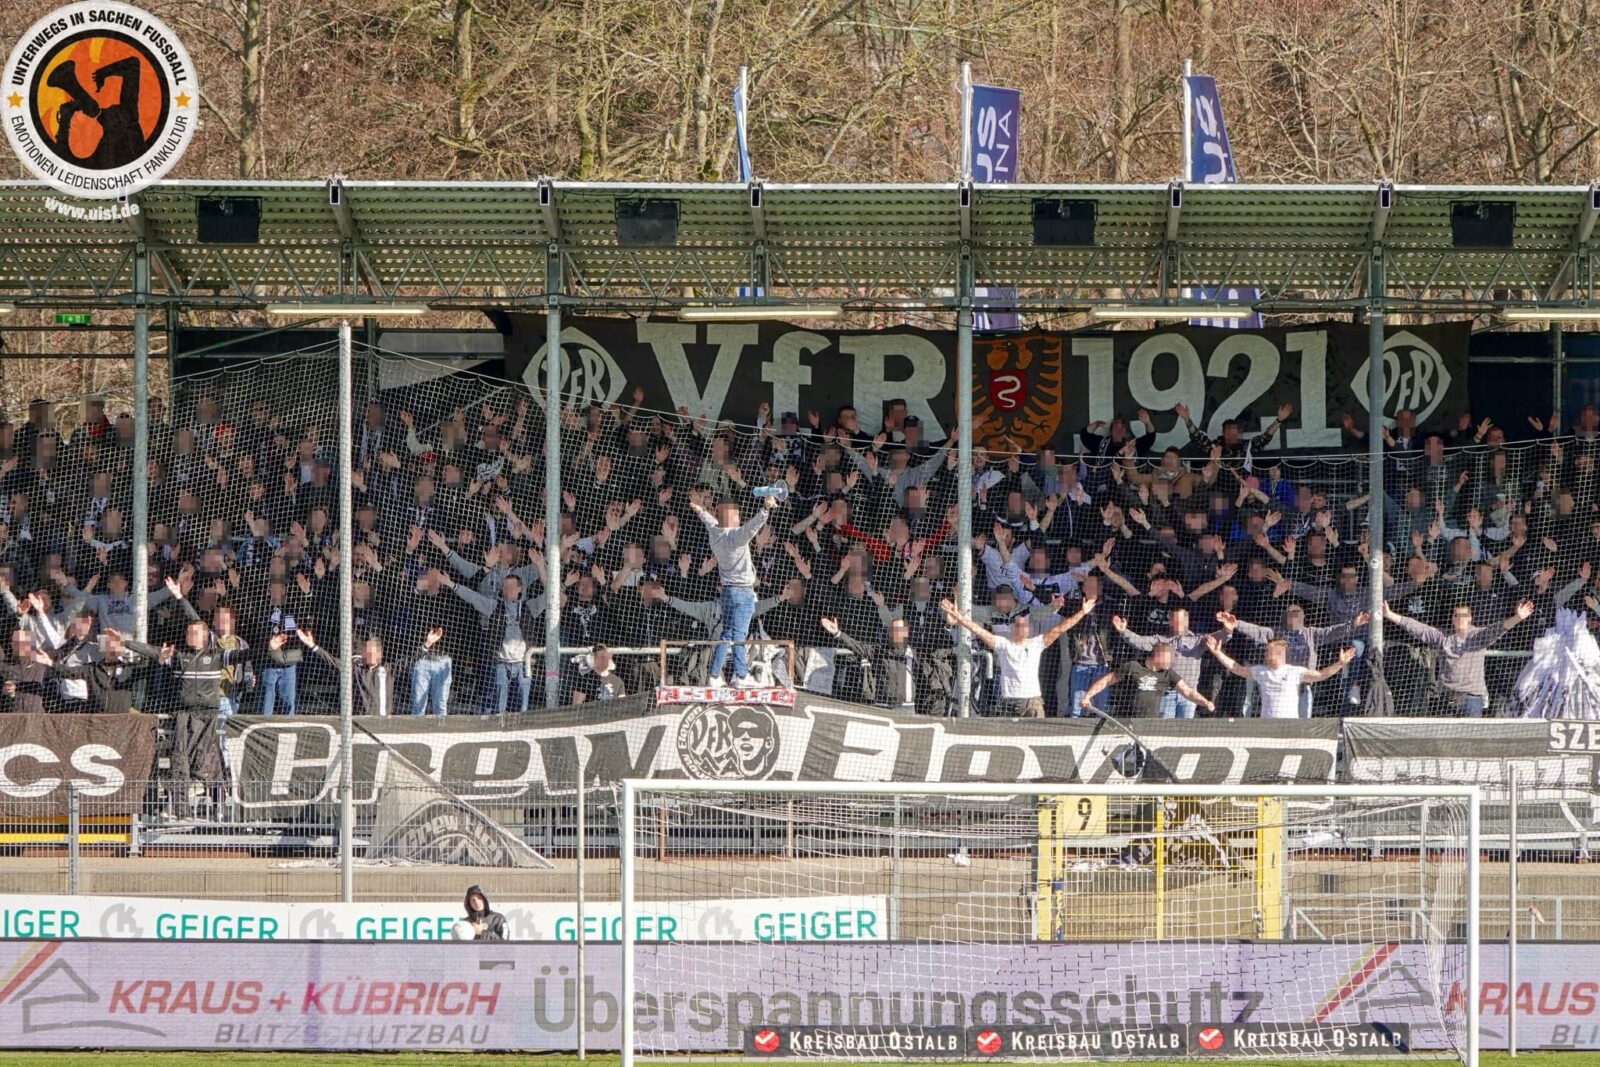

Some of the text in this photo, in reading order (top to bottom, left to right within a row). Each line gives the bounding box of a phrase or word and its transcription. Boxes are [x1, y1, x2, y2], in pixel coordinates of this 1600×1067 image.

[1071, 328, 1343, 452] 1921
[1078, 797, 1092, 831] 9
[156, 913, 279, 940] GEIGER
[356, 917, 466, 941] GEIGE
[754, 910, 877, 941] GEIGER
[108, 979, 262, 1015] KRAUS
[301, 975, 502, 1016] KÜBRICH
[789, 1031, 958, 1050] KREISBAU OSTALB
[1012, 1030, 1180, 1050] KREISBAU OSTALB
[1233, 1028, 1402, 1048] KREISBAU OSTALB
